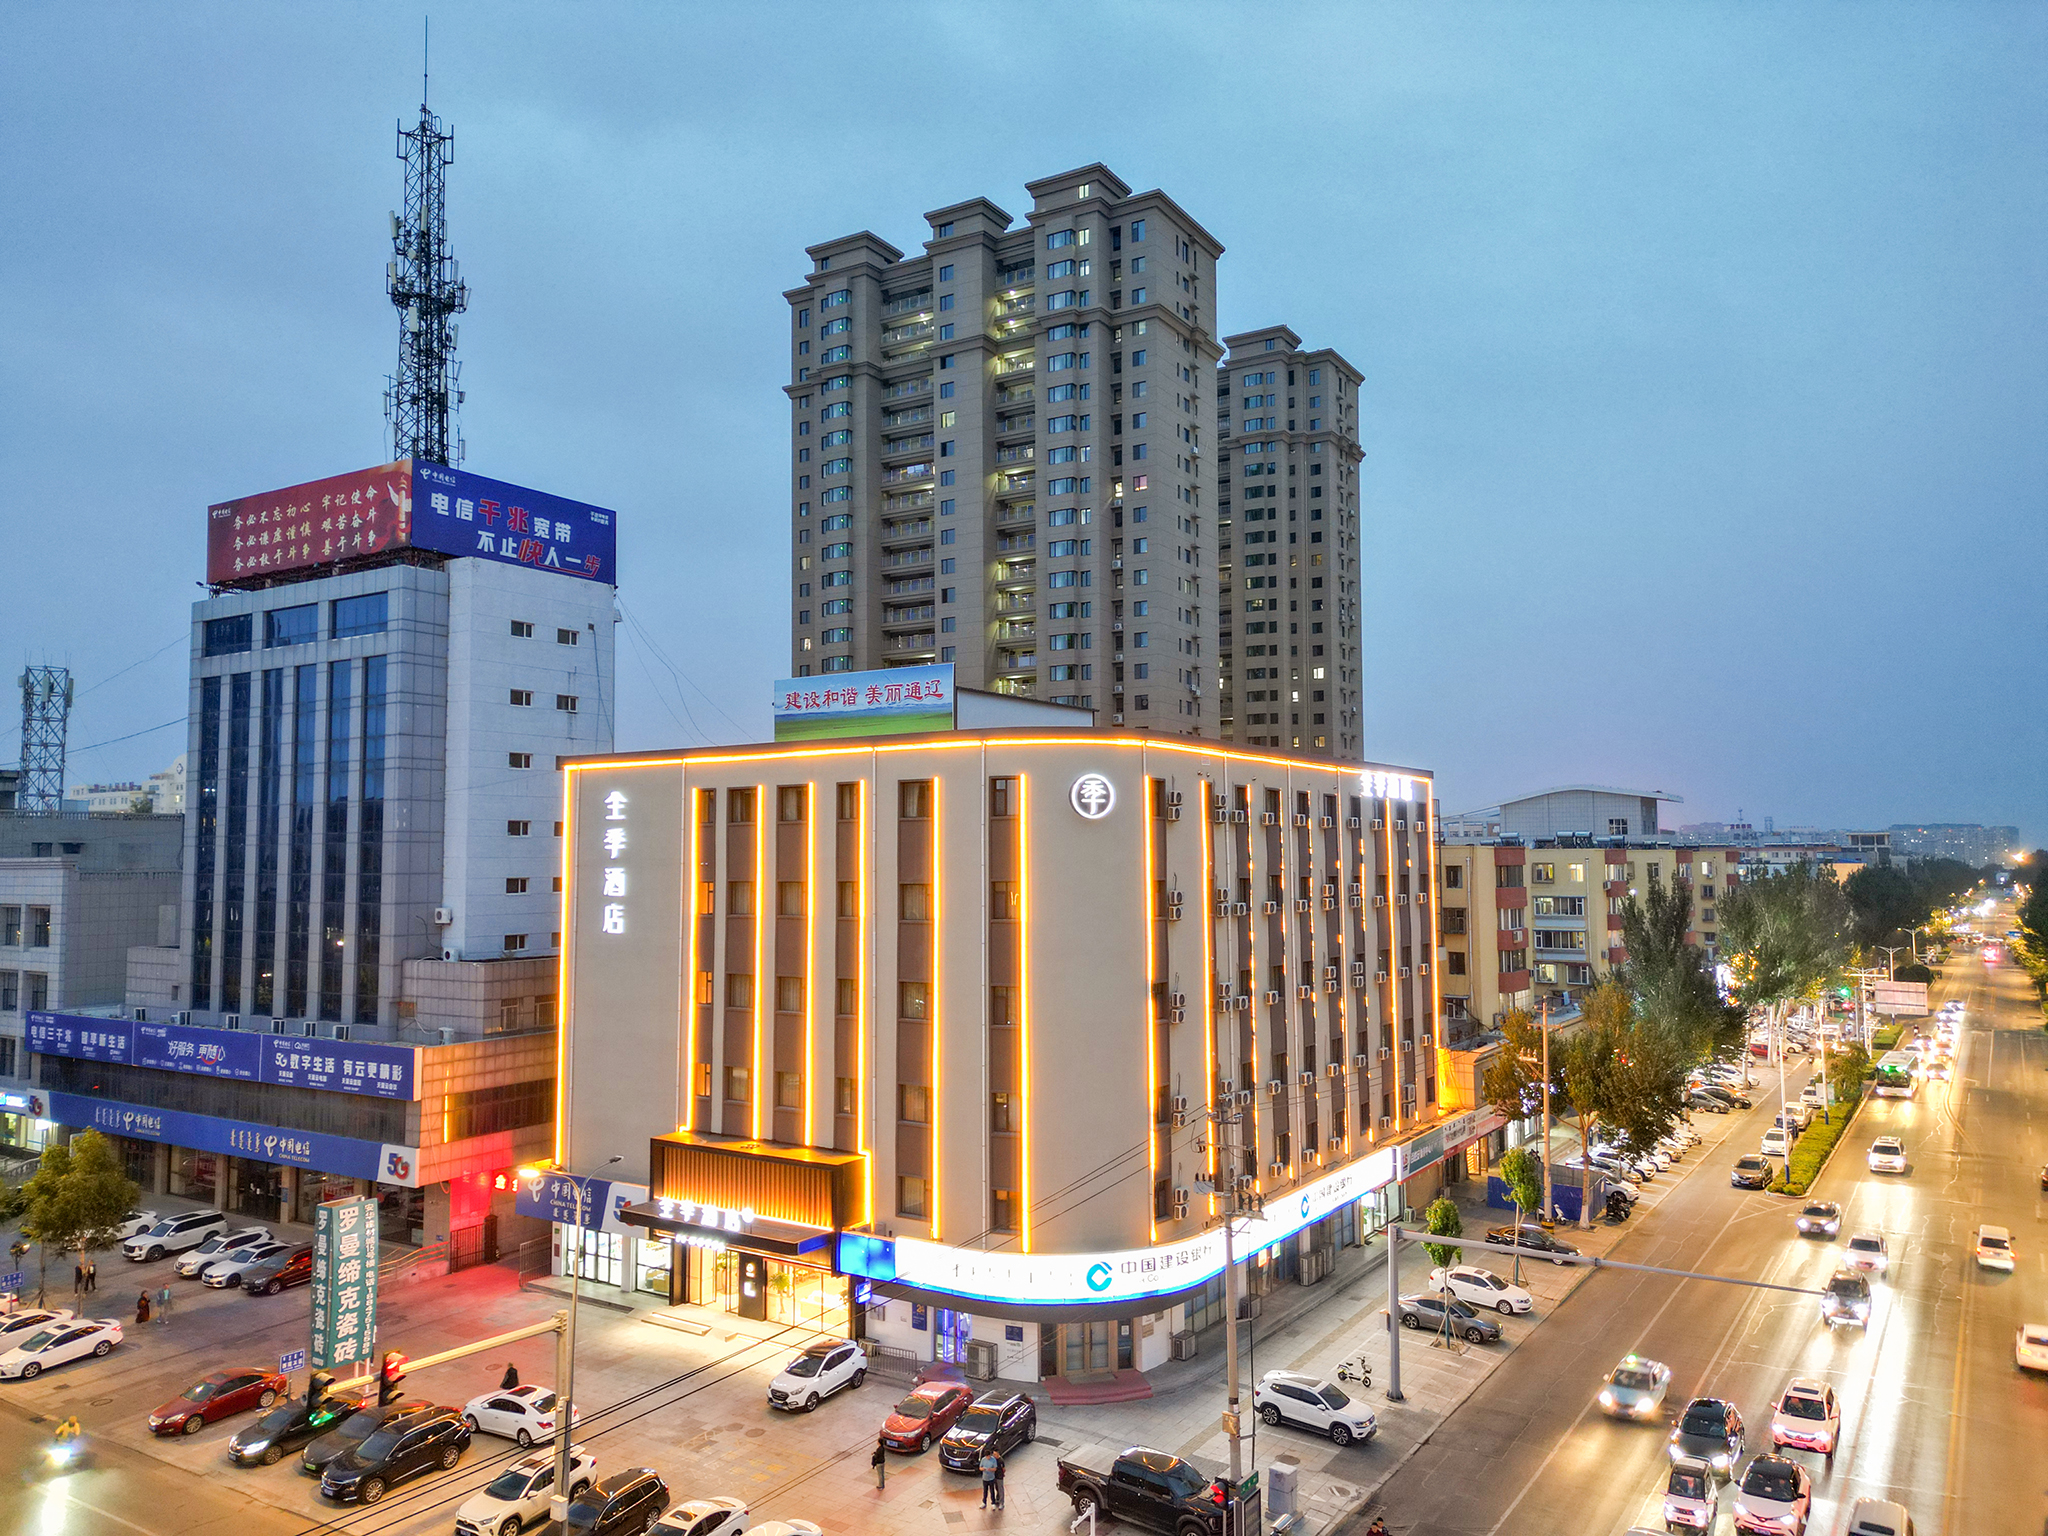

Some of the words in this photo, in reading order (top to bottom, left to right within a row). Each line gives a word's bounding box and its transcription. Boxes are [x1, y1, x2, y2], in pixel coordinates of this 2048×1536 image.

[233, 502, 311, 530] 务必不忘初心
[321, 484, 378, 511] 牢记使命
[430, 492, 571, 544] 电信千兆宽带
[233, 521, 312, 551] 务必谦虚谨慎
[321, 507, 377, 533] 艰苦奋斗
[233, 543, 310, 572] 务必敢于斗争
[321, 530, 377, 557] 善于斗争
[476, 530, 601, 575] 不止快人一步
[784, 686, 858, 710] 建设和谐
[864, 679, 944, 705] 美丽通辽
[602, 790, 628, 935] 全季酒店
[167, 1040, 195, 1060] 好服务
[342, 1059, 403, 1082] 有云更精彩
[28, 1095, 43, 1116] 5G
[134, 1113, 161, 1130] 中国电信
[279, 1136, 311, 1156] 中国电信
[387, 1152, 410, 1180] 5G
[549, 1199, 566, 1208] CHINA
[566, 1202, 592, 1212] TELOM
[333, 1205, 362, 1363] 罗曼缔克瓷砖
